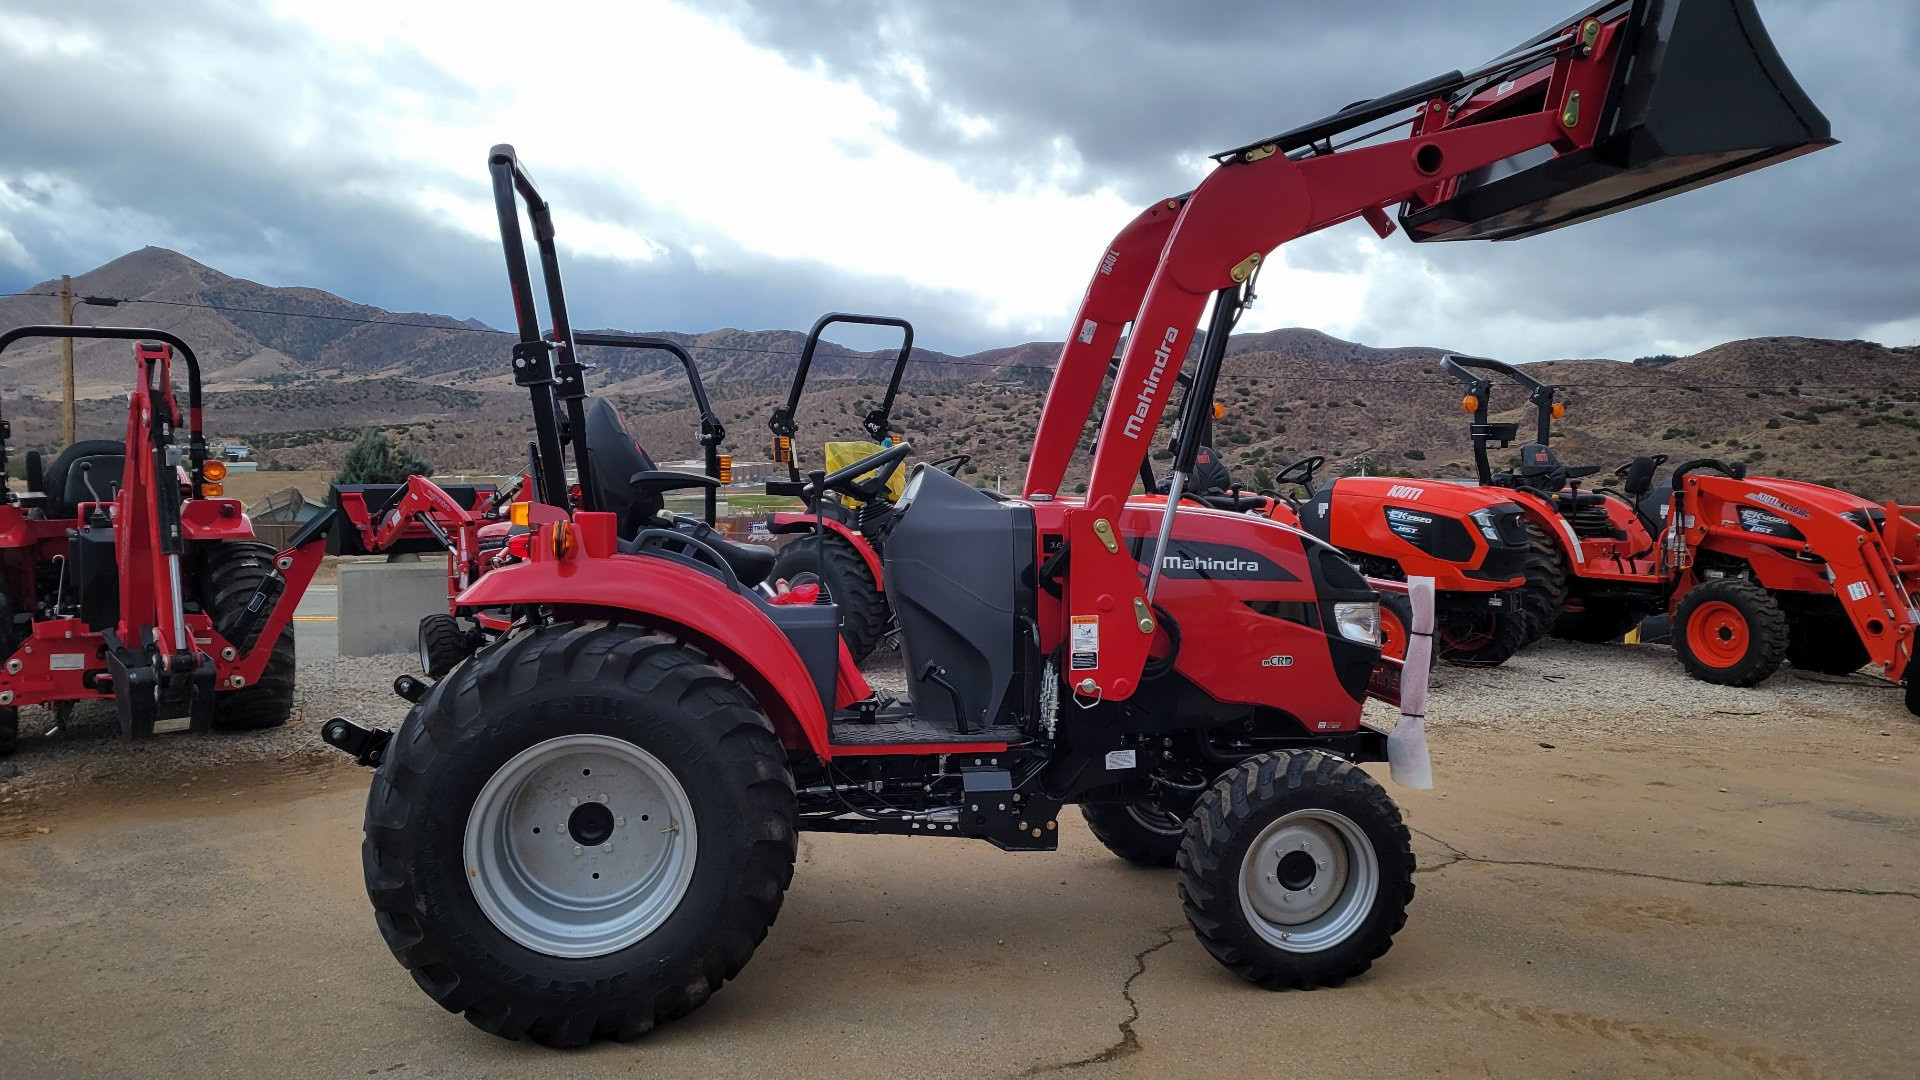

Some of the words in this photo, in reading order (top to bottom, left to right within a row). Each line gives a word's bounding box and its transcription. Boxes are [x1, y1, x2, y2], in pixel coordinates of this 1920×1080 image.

[1123, 326, 1179, 440] Mahindra
[1386, 484, 1425, 501] KIOTI
[1162, 556, 1259, 572] Mahindra
[1263, 656, 1293, 666] mCRD
